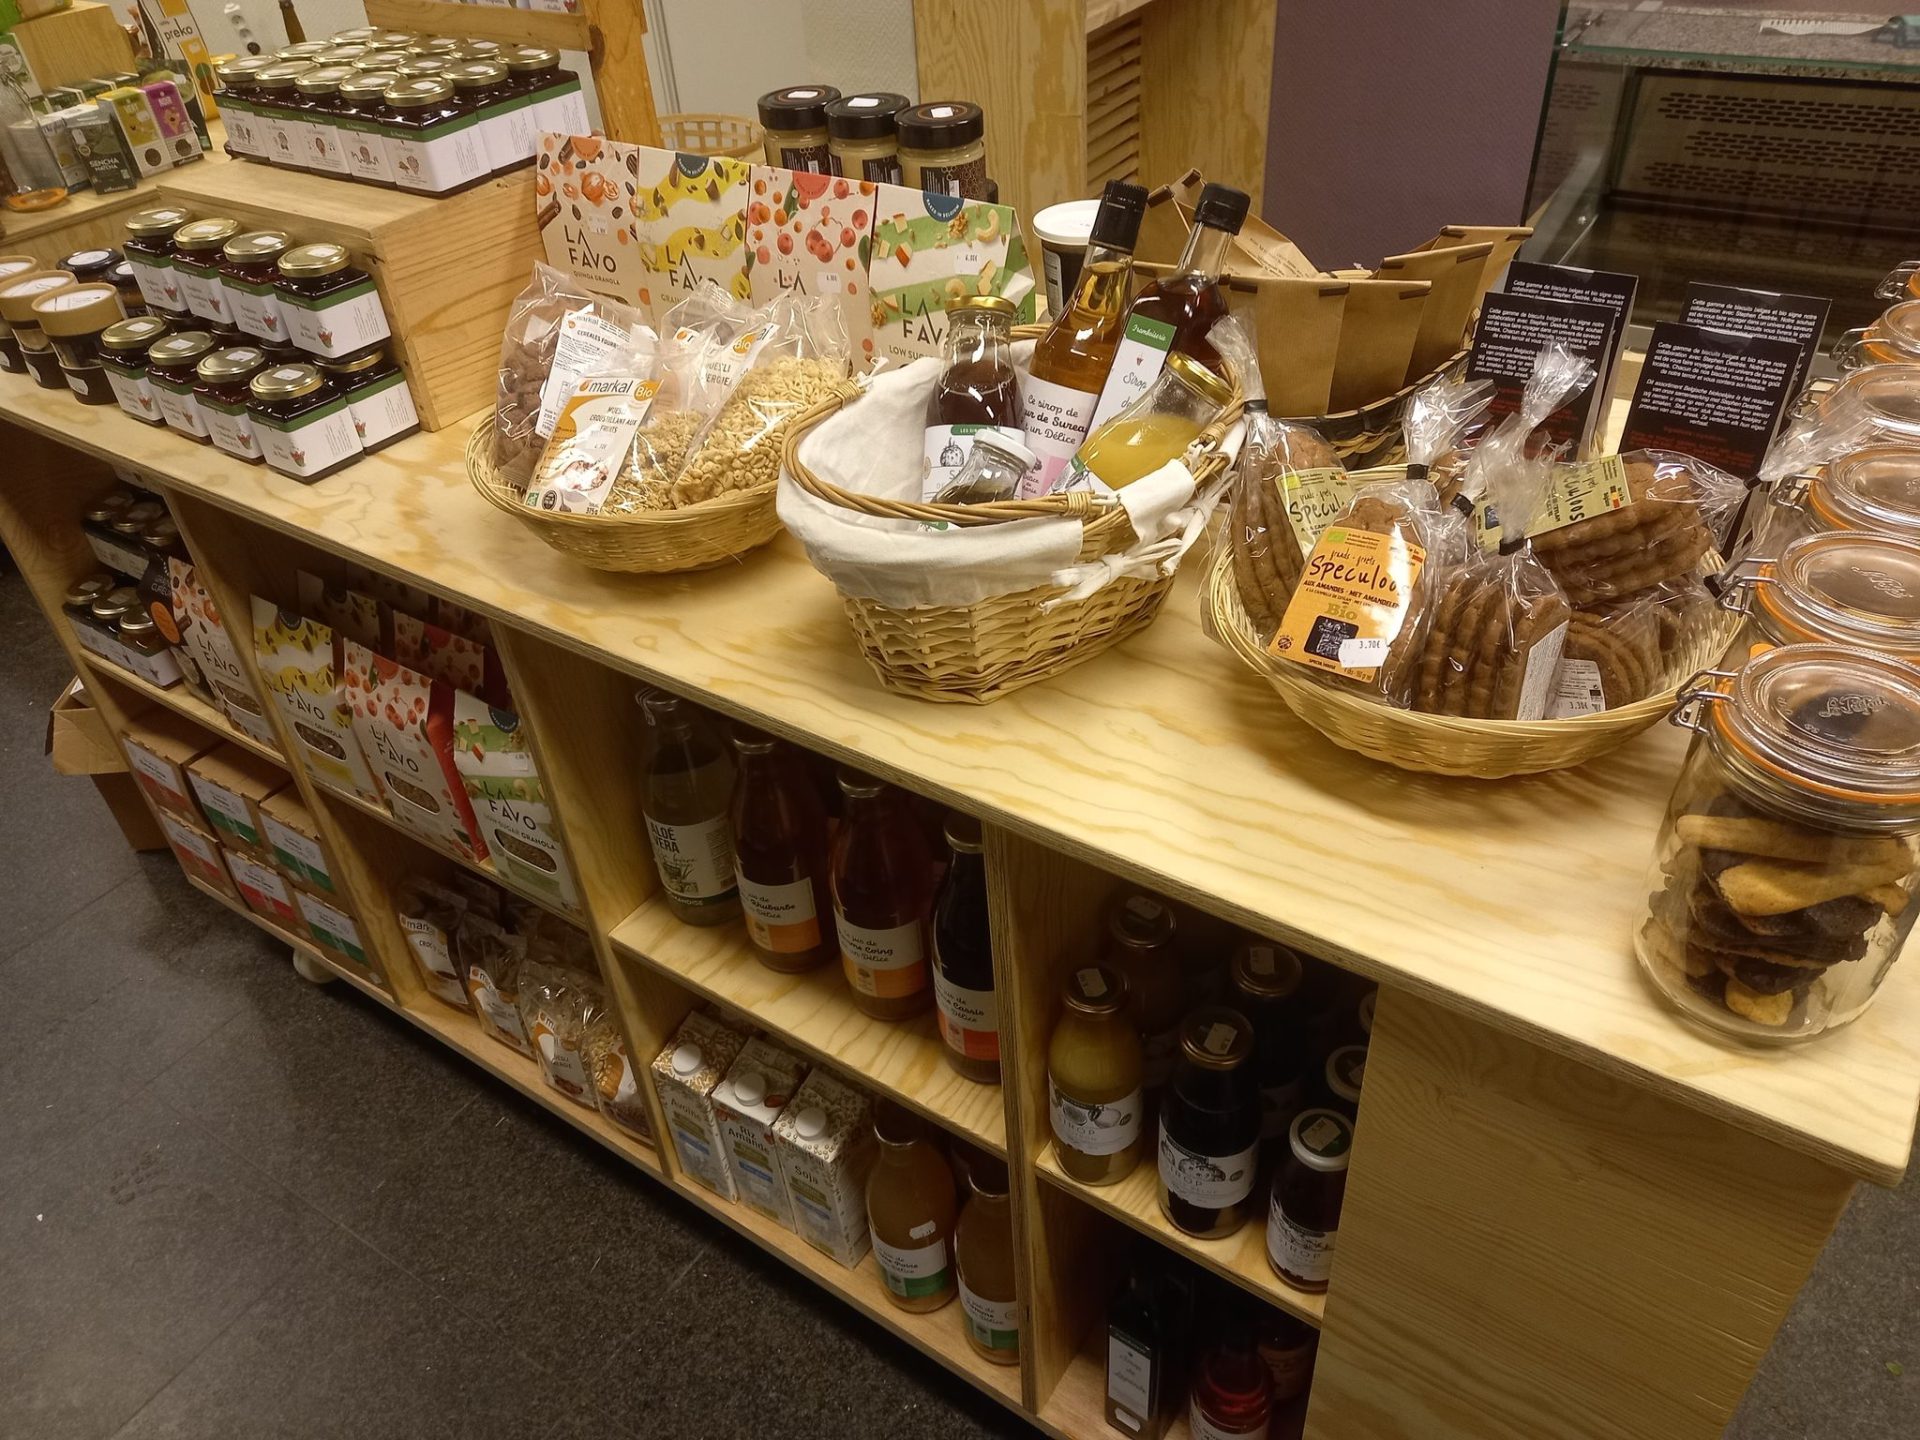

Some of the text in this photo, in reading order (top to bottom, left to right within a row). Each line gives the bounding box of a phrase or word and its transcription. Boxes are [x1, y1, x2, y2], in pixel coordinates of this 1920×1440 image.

[163, 25, 193, 42] preko
[89, 158, 120, 168] SENCHA
[926, 199, 937, 214] BAKED
[564, 224, 590, 246] LA
[568, 247, 617, 273] FAVO
[666, 245, 692, 266] LA
[779, 269, 807, 295] LA
[902, 293, 929, 318] LA
[903, 319, 944, 346] FAV
[889, 345, 907, 357] LOW
[588, 380, 652, 398] markal Bio
[1122, 371, 1148, 392] Sirop
[1028, 394, 1037, 406] Ce
[1037, 399, 1063, 416] sirop
[1066, 404, 1079, 418] de
[1037, 412, 1049, 424] de
[1052, 417, 1087, 433] Surea
[1030, 425, 1042, 437] un
[1044, 427, 1076, 445] Délice
[1316, 582, 1344, 594] AMANDES
[1349, 590, 1363, 599] MET
[1325, 602, 1358, 621] Bio
[196, 634, 215, 651] LA
[1359, 640, 1380, 649] 3.70€
[203, 651, 239, 677] FAVO
[280, 675, 298, 693] LA
[286, 692, 325, 720] FAVO
[371, 724, 390, 743] LA
[376, 741, 419, 772] FAVO
[483, 781, 506, 800] LA
[488, 799, 537, 830] FAVO
[656, 837, 680, 853] VERA
[865, 946, 893, 956] Coing
[740, 1125, 758, 1141] Riz
[794, 1165, 819, 1185] Soja
